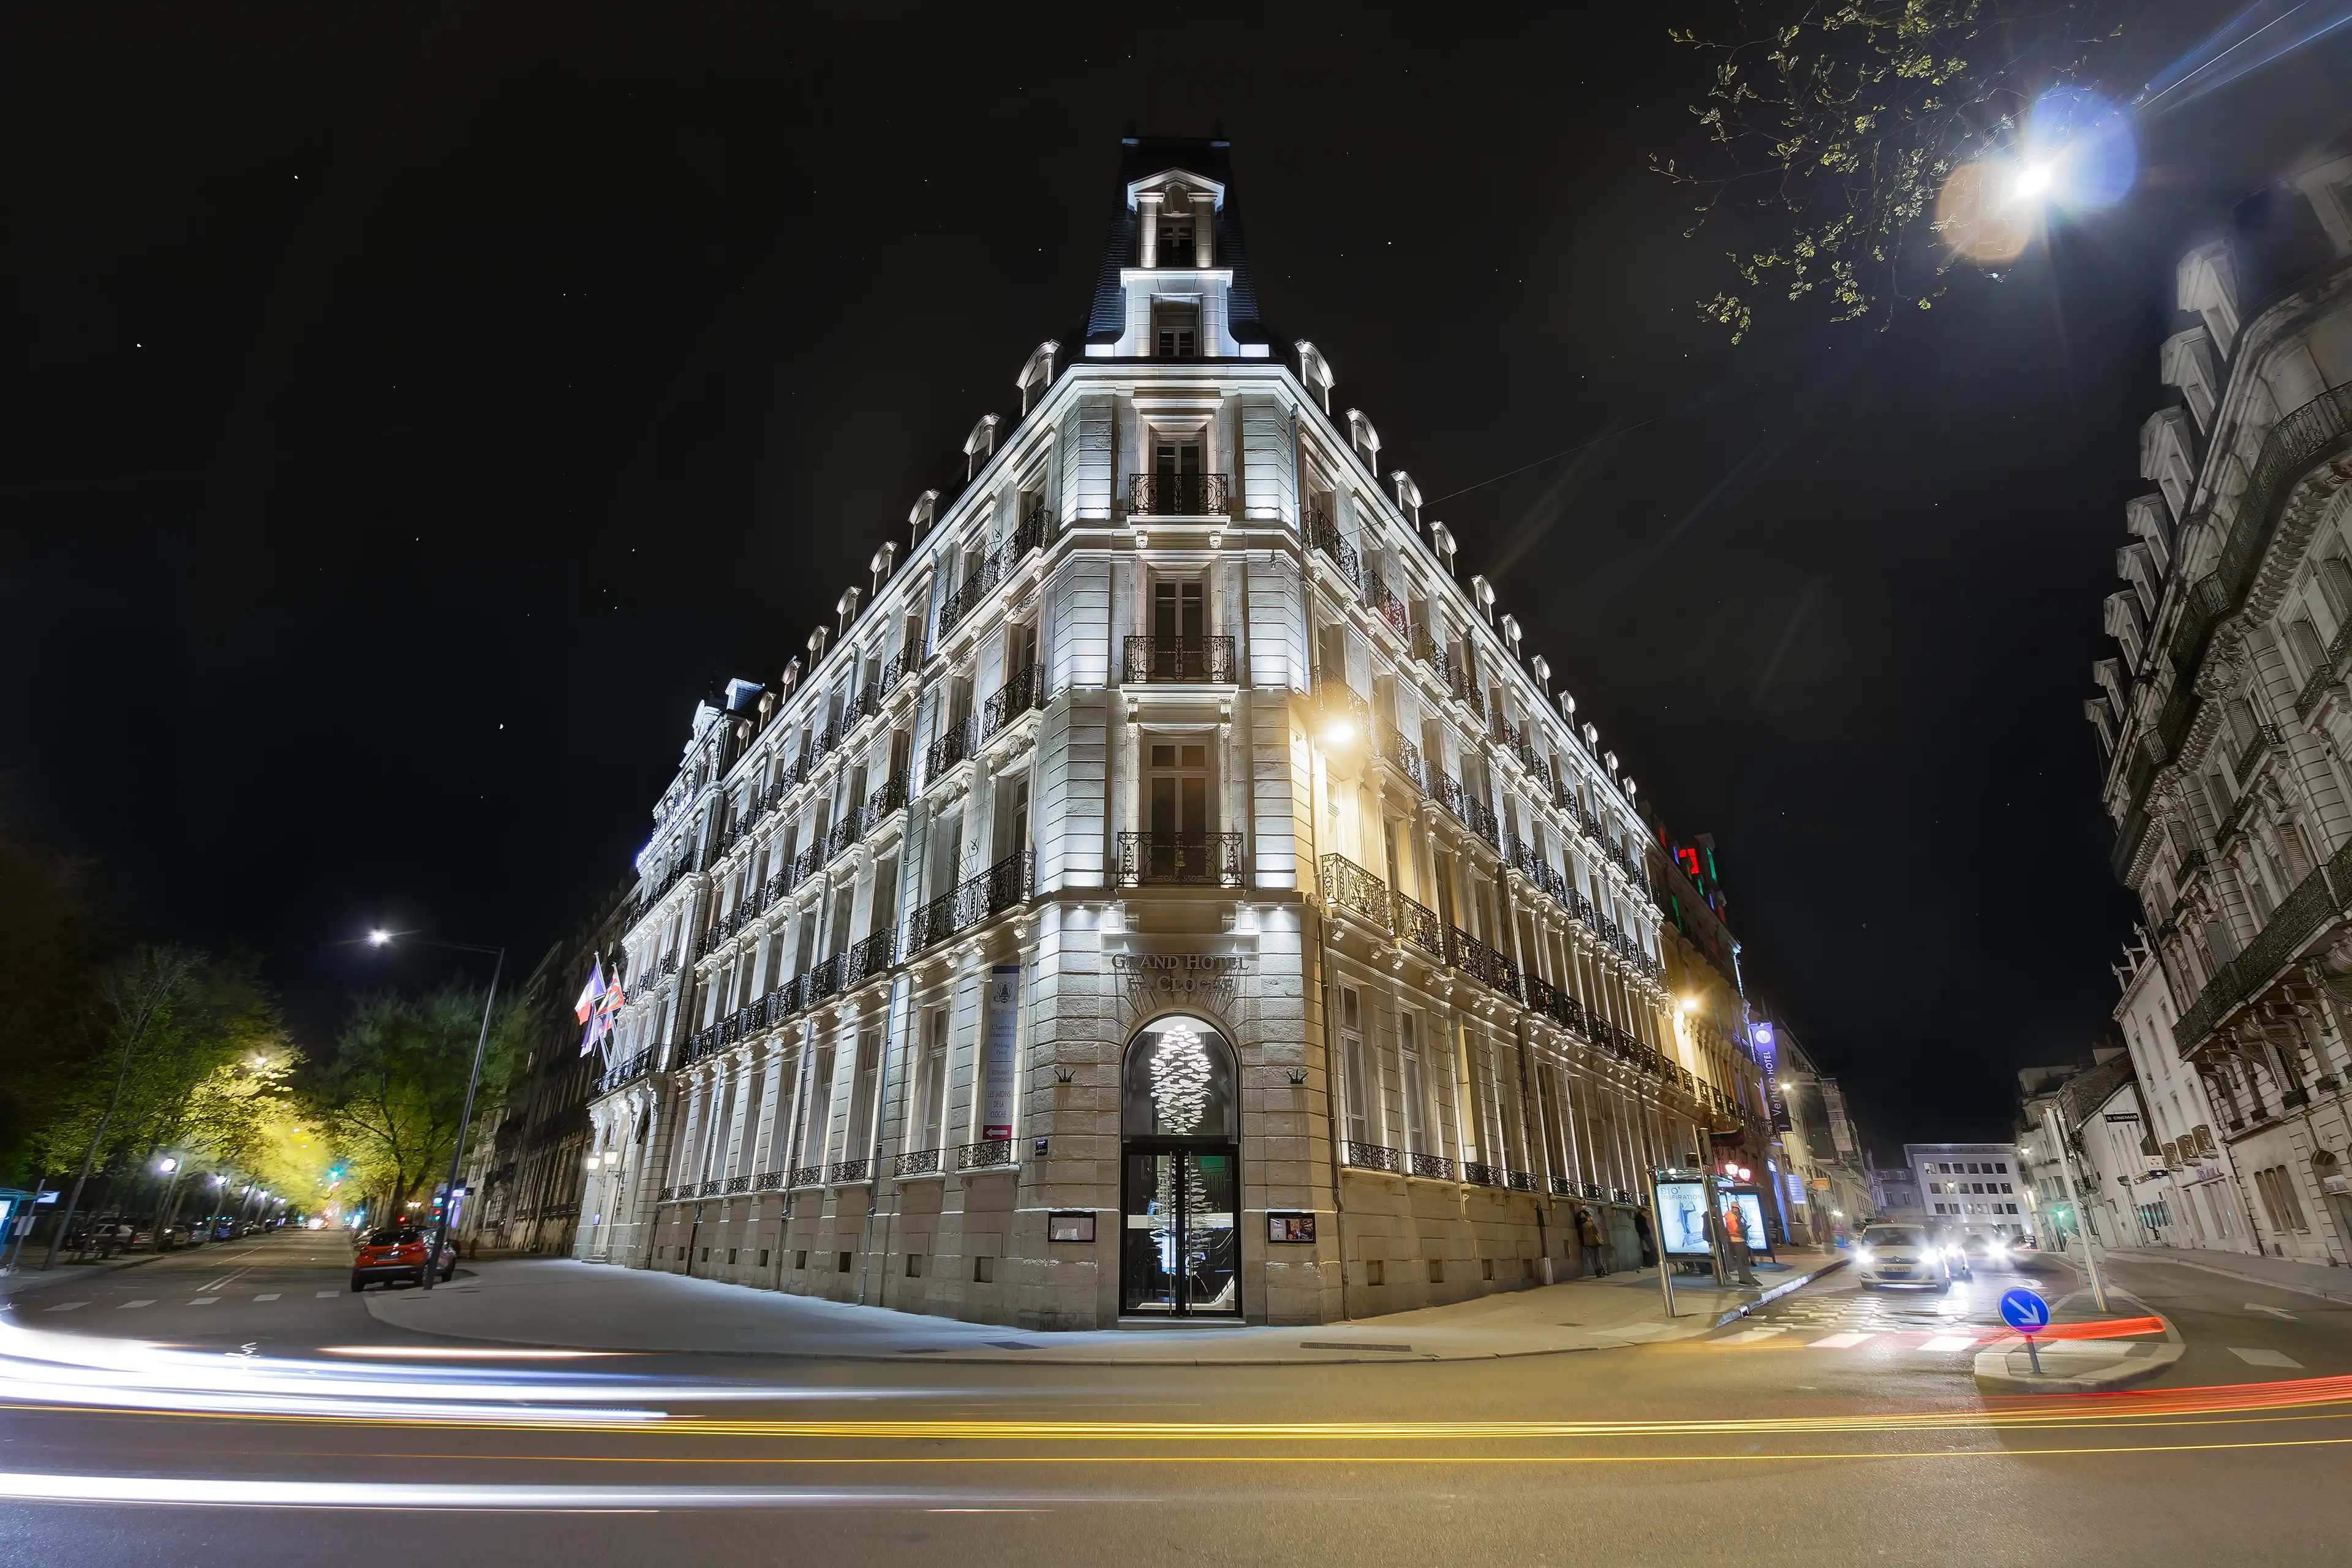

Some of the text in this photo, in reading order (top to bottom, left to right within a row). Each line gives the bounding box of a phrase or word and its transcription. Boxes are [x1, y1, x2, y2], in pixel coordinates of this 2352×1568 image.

[1112, 952, 1250, 971] GRAND HOTEL
[1126, 975, 1234, 993] LA CLOCHE
[1763, 1050, 1782, 1116] Vertigo HOTEL
